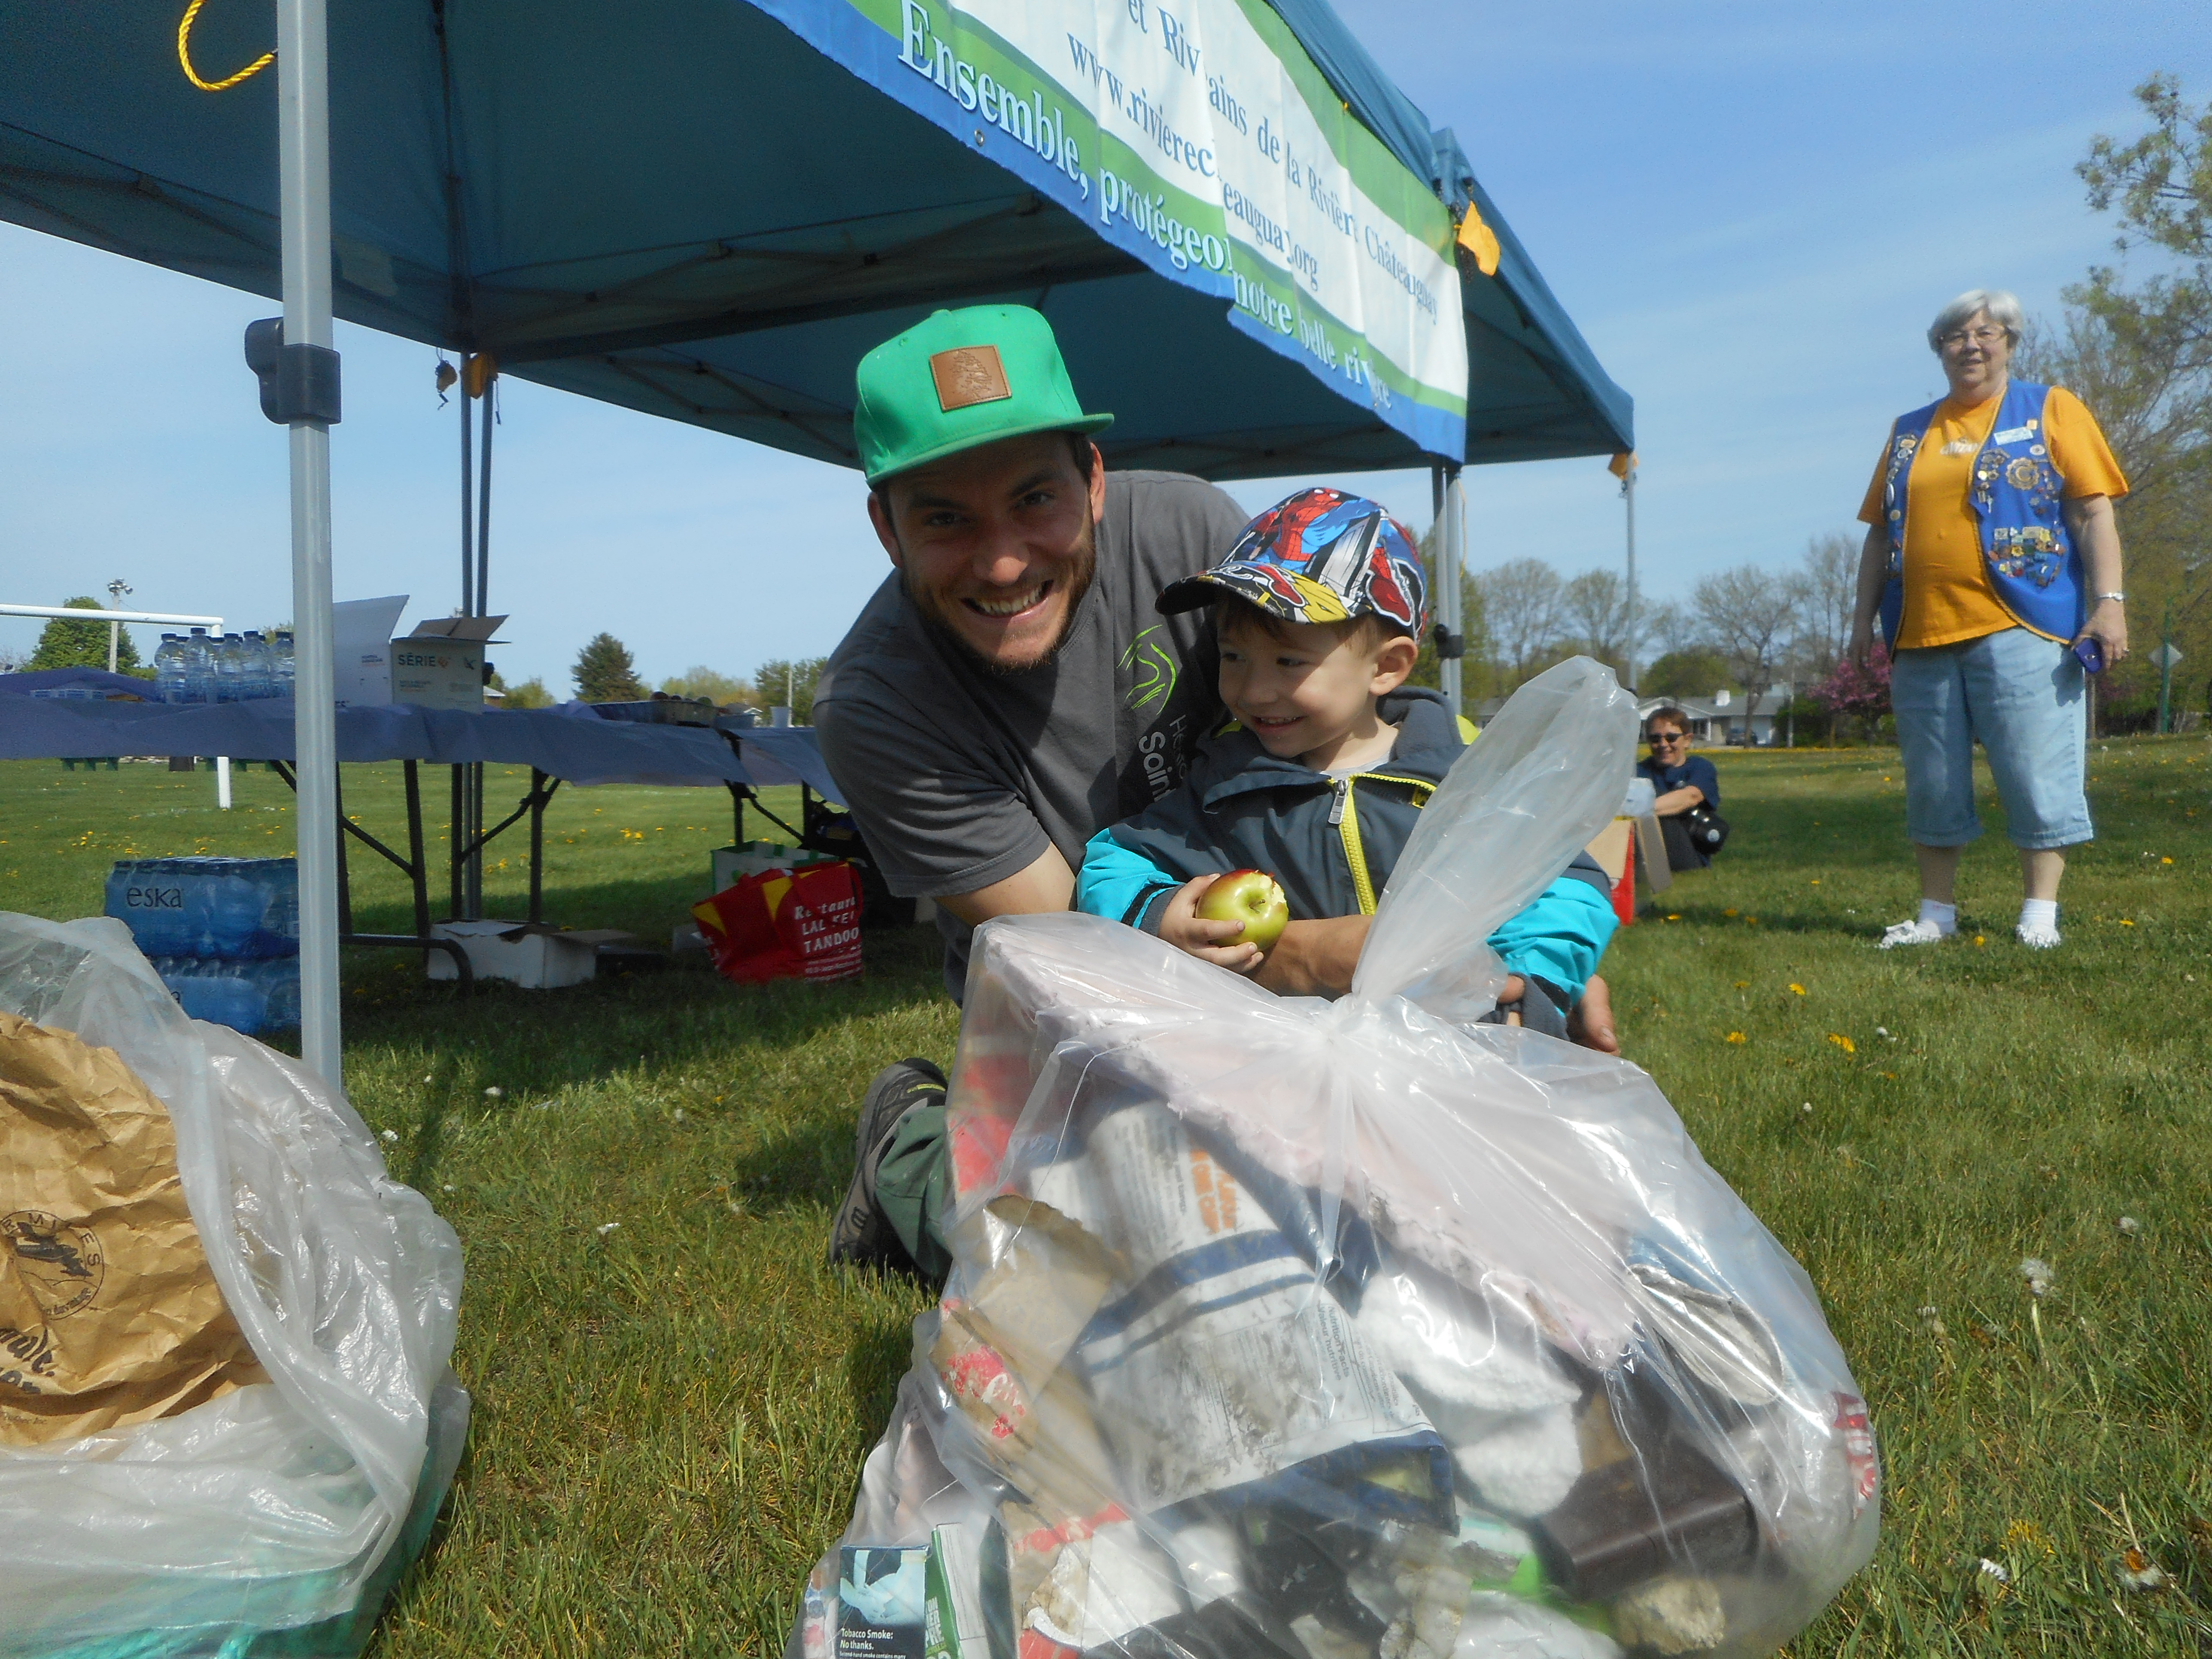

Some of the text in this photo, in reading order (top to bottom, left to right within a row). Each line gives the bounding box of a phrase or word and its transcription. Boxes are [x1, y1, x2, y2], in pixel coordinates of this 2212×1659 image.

[1258, 116, 1280, 164] de
[1287, 142, 1301, 188] la
[898, 0, 1088, 200] Ensemble,
[1232, 271, 1293, 335] notre
[398, 653, 436, 666] SÉRIE
[127, 887, 182, 907] eska
[802, 919, 826, 935] LAL
[1325, 1339, 1342, 1381] nutritive
[842, 1628, 893, 1640] Tobacco Smoke:
[840, 1640, 874, 1650] No thanks.
